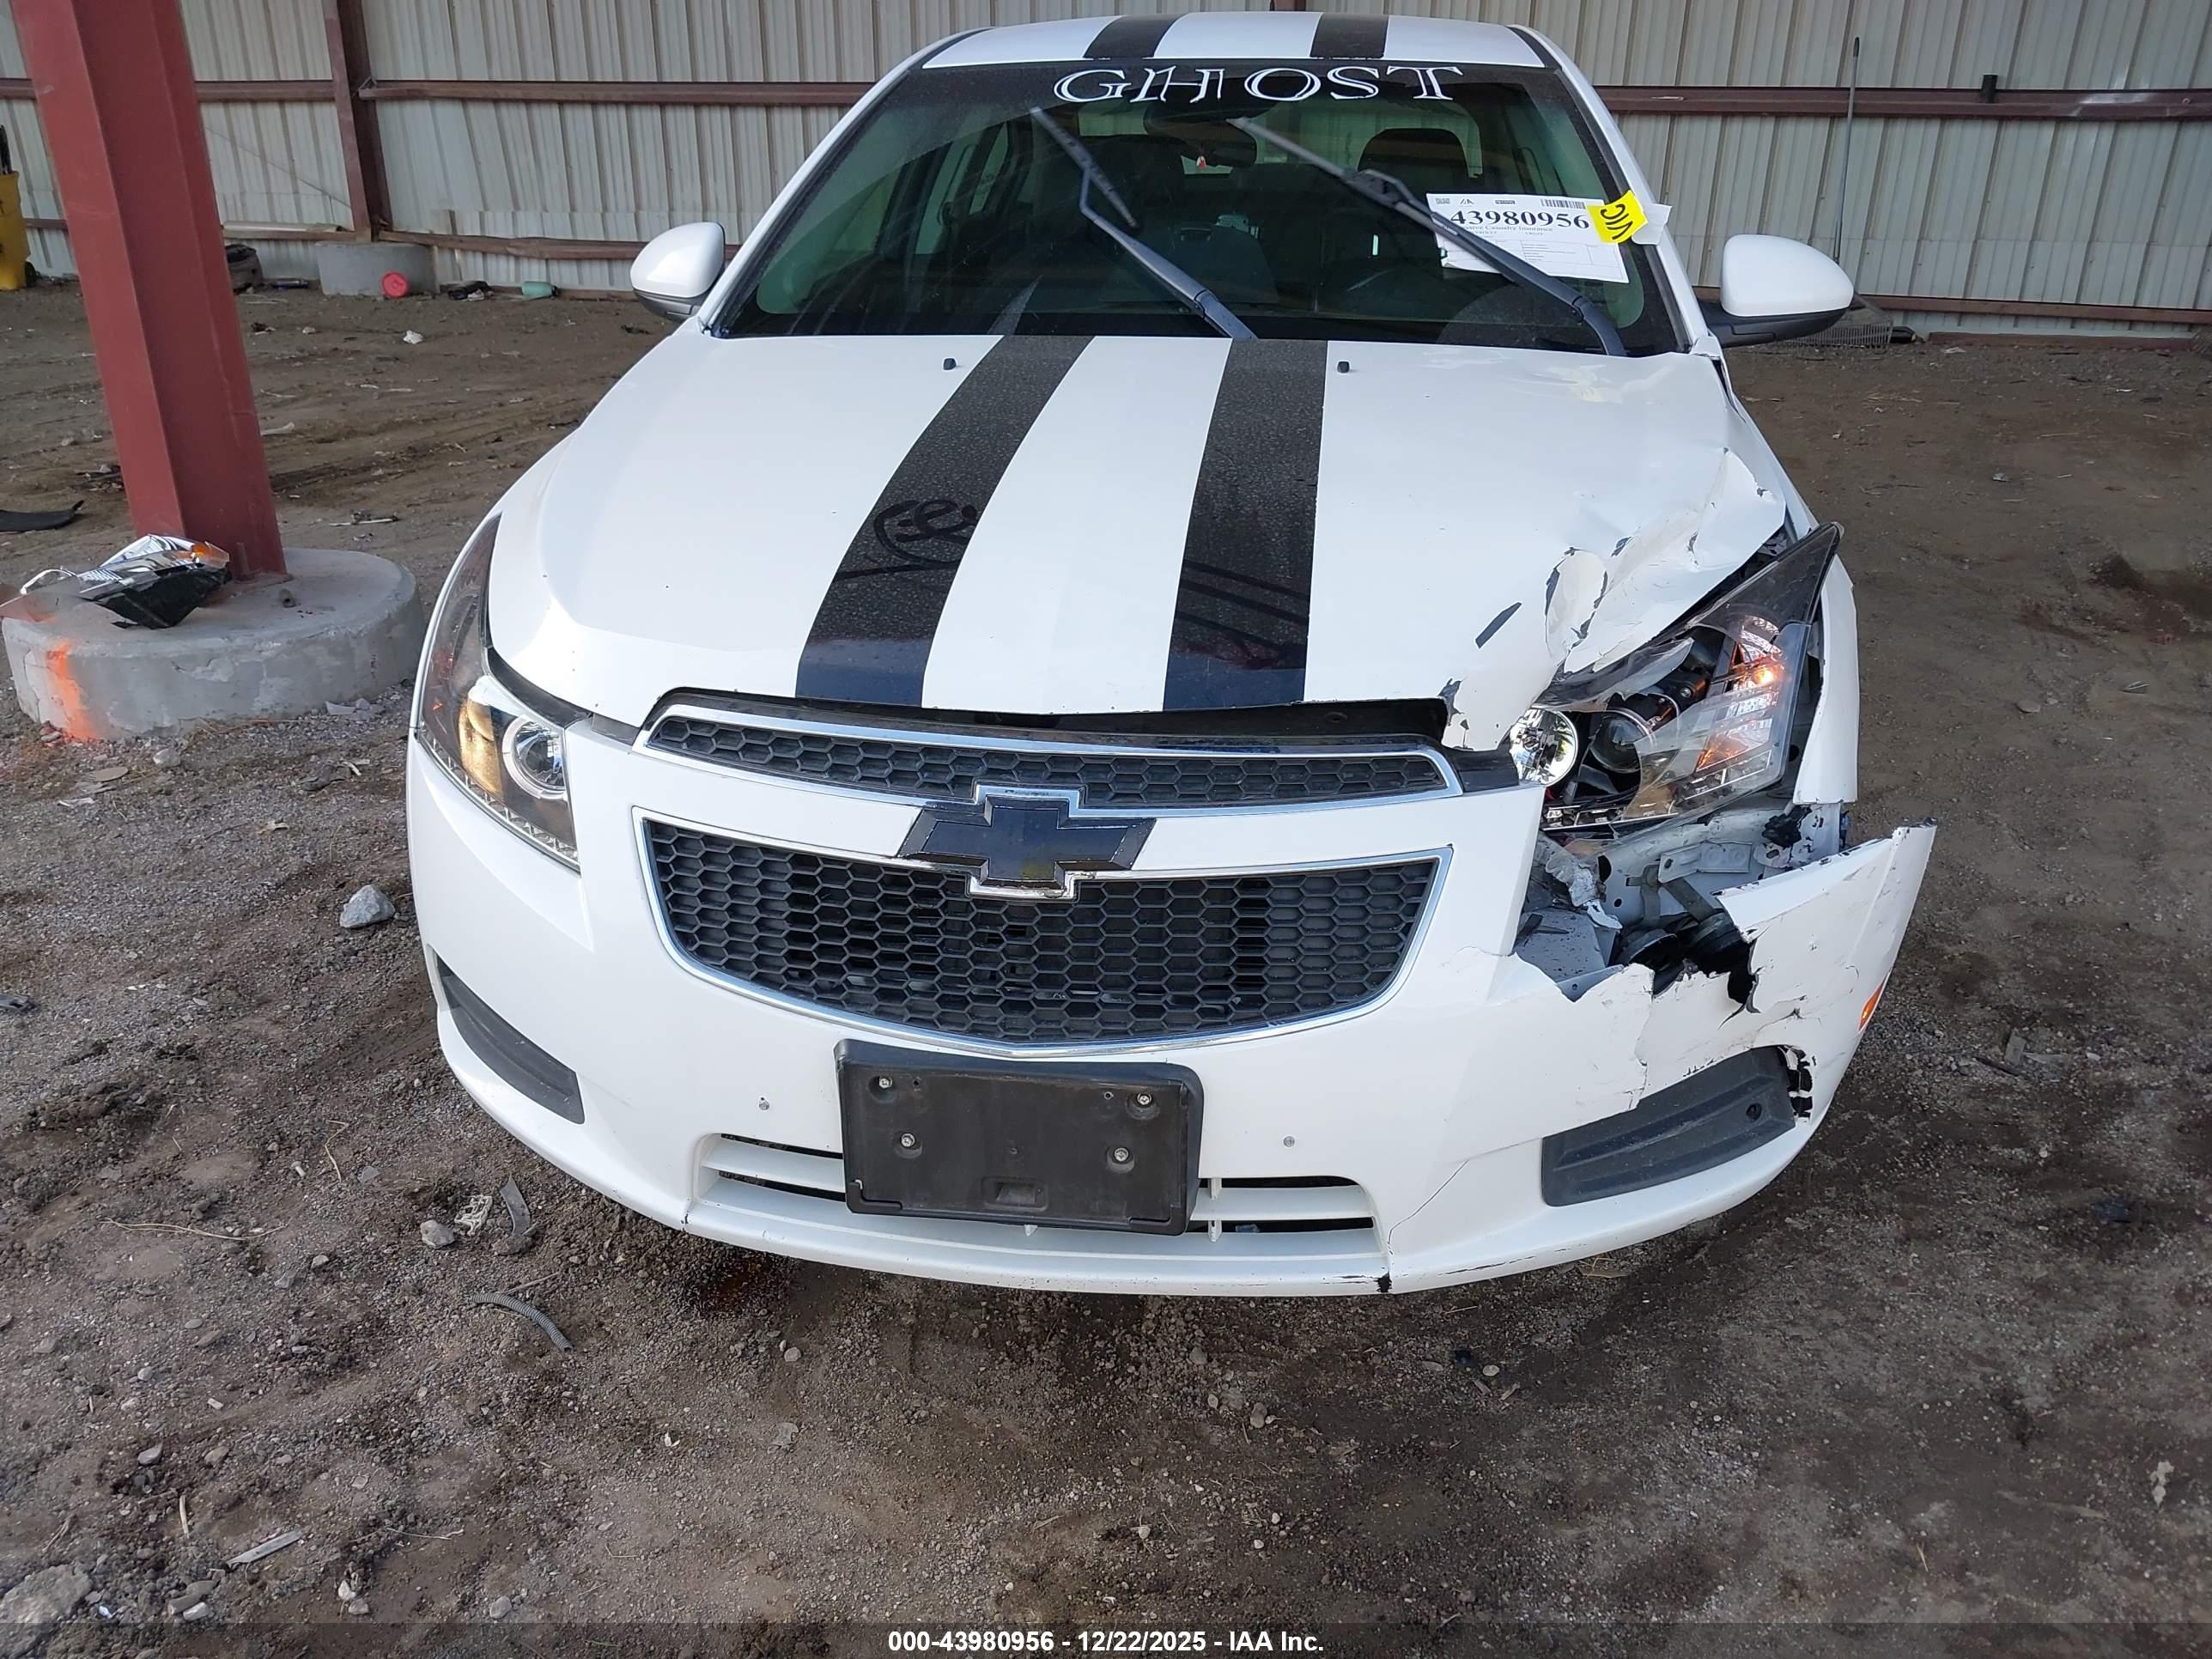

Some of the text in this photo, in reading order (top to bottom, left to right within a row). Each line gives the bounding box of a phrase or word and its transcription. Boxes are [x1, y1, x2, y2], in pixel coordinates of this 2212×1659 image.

[1053, 65, 1464, 103] GHOST
[1449, 210, 1589, 229] 43980956
[1600, 204, 1633, 240] VIC
